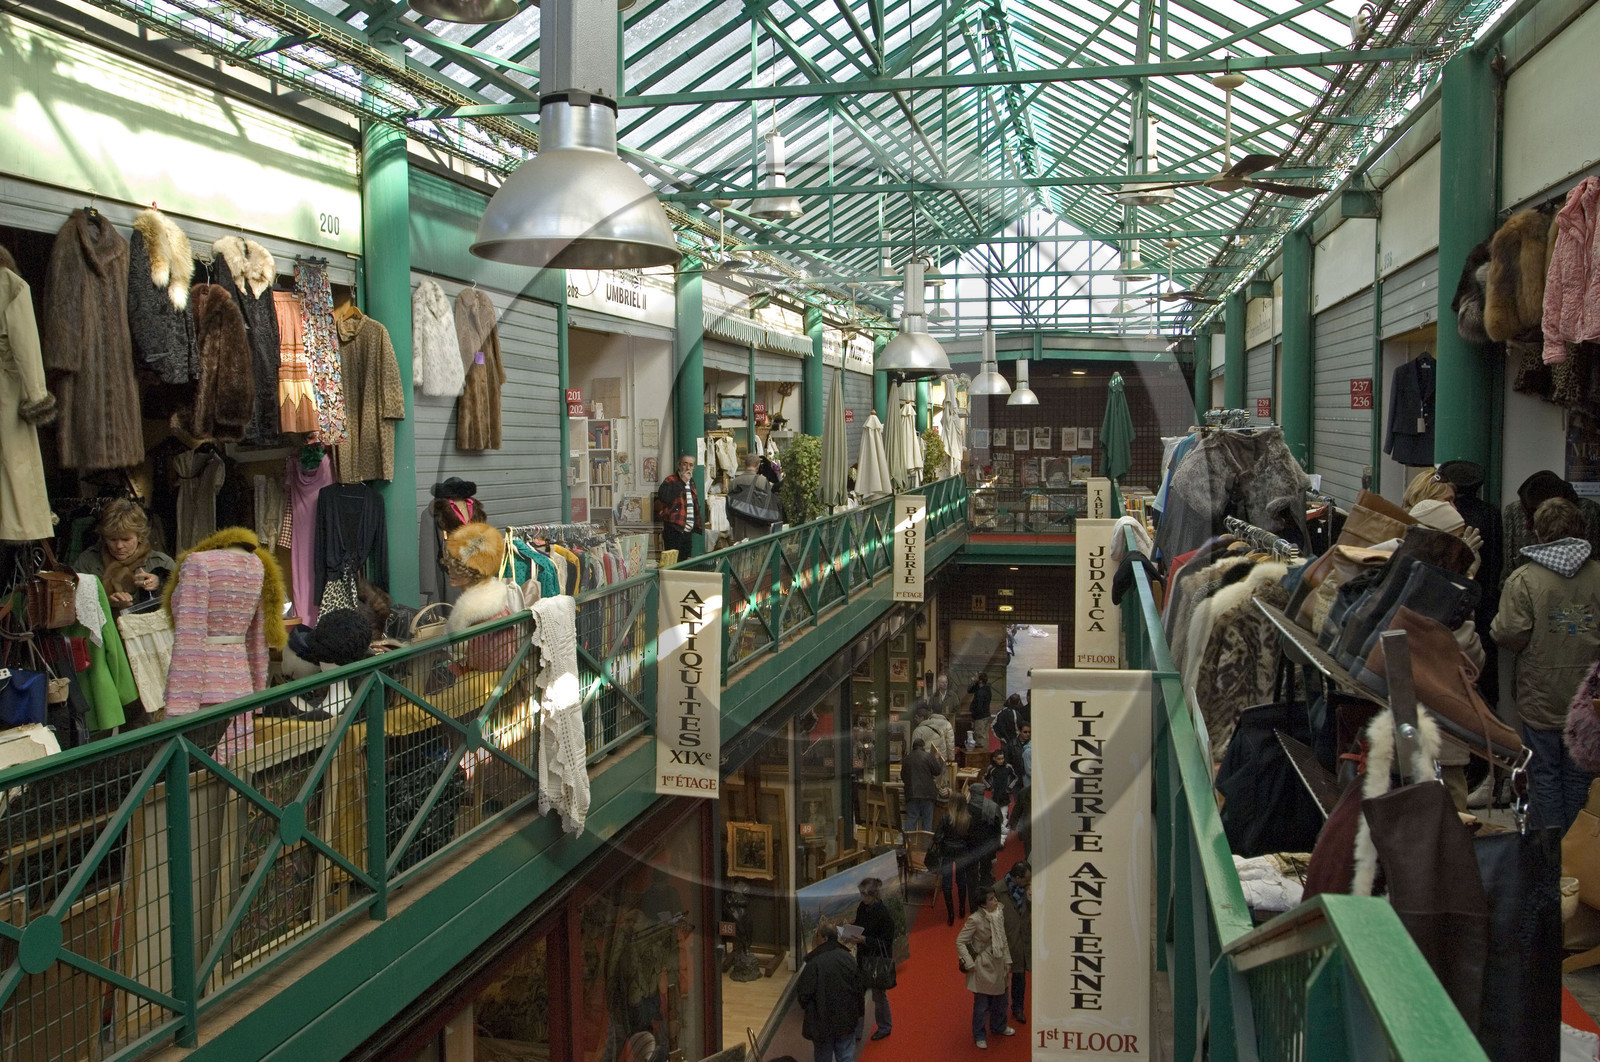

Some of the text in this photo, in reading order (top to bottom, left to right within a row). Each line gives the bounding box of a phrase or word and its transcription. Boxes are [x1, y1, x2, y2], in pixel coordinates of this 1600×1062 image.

[320, 212, 340, 235] 200
[567, 285, 579, 298] 202
[606, 283, 640, 308] UMBRIEL
[1352, 381, 1369, 391] 237
[568, 391, 581, 401] 201
[1352, 396, 1370, 407] 236
[569, 405, 583, 414] 202
[755, 404, 765, 412] 203
[904, 506, 917, 584] BIJOUTERIE
[1087, 546, 1107, 632] JUDAÏCA
[1077, 654, 1116, 664] 1st FLOOR
[678, 589, 705, 747] ANTIQUITES
[670, 750, 712, 766] XIXe
[662, 774, 717, 790] 1er ÉTAGE
[1070, 701, 1107, 852] LINGERIE
[802, 825, 812, 833] 49
[721, 925, 734, 934] 48
[1069, 862, 1107, 1010] ANCIENNE
[1037, 1028, 1140, 1053] 1st FLOOR
